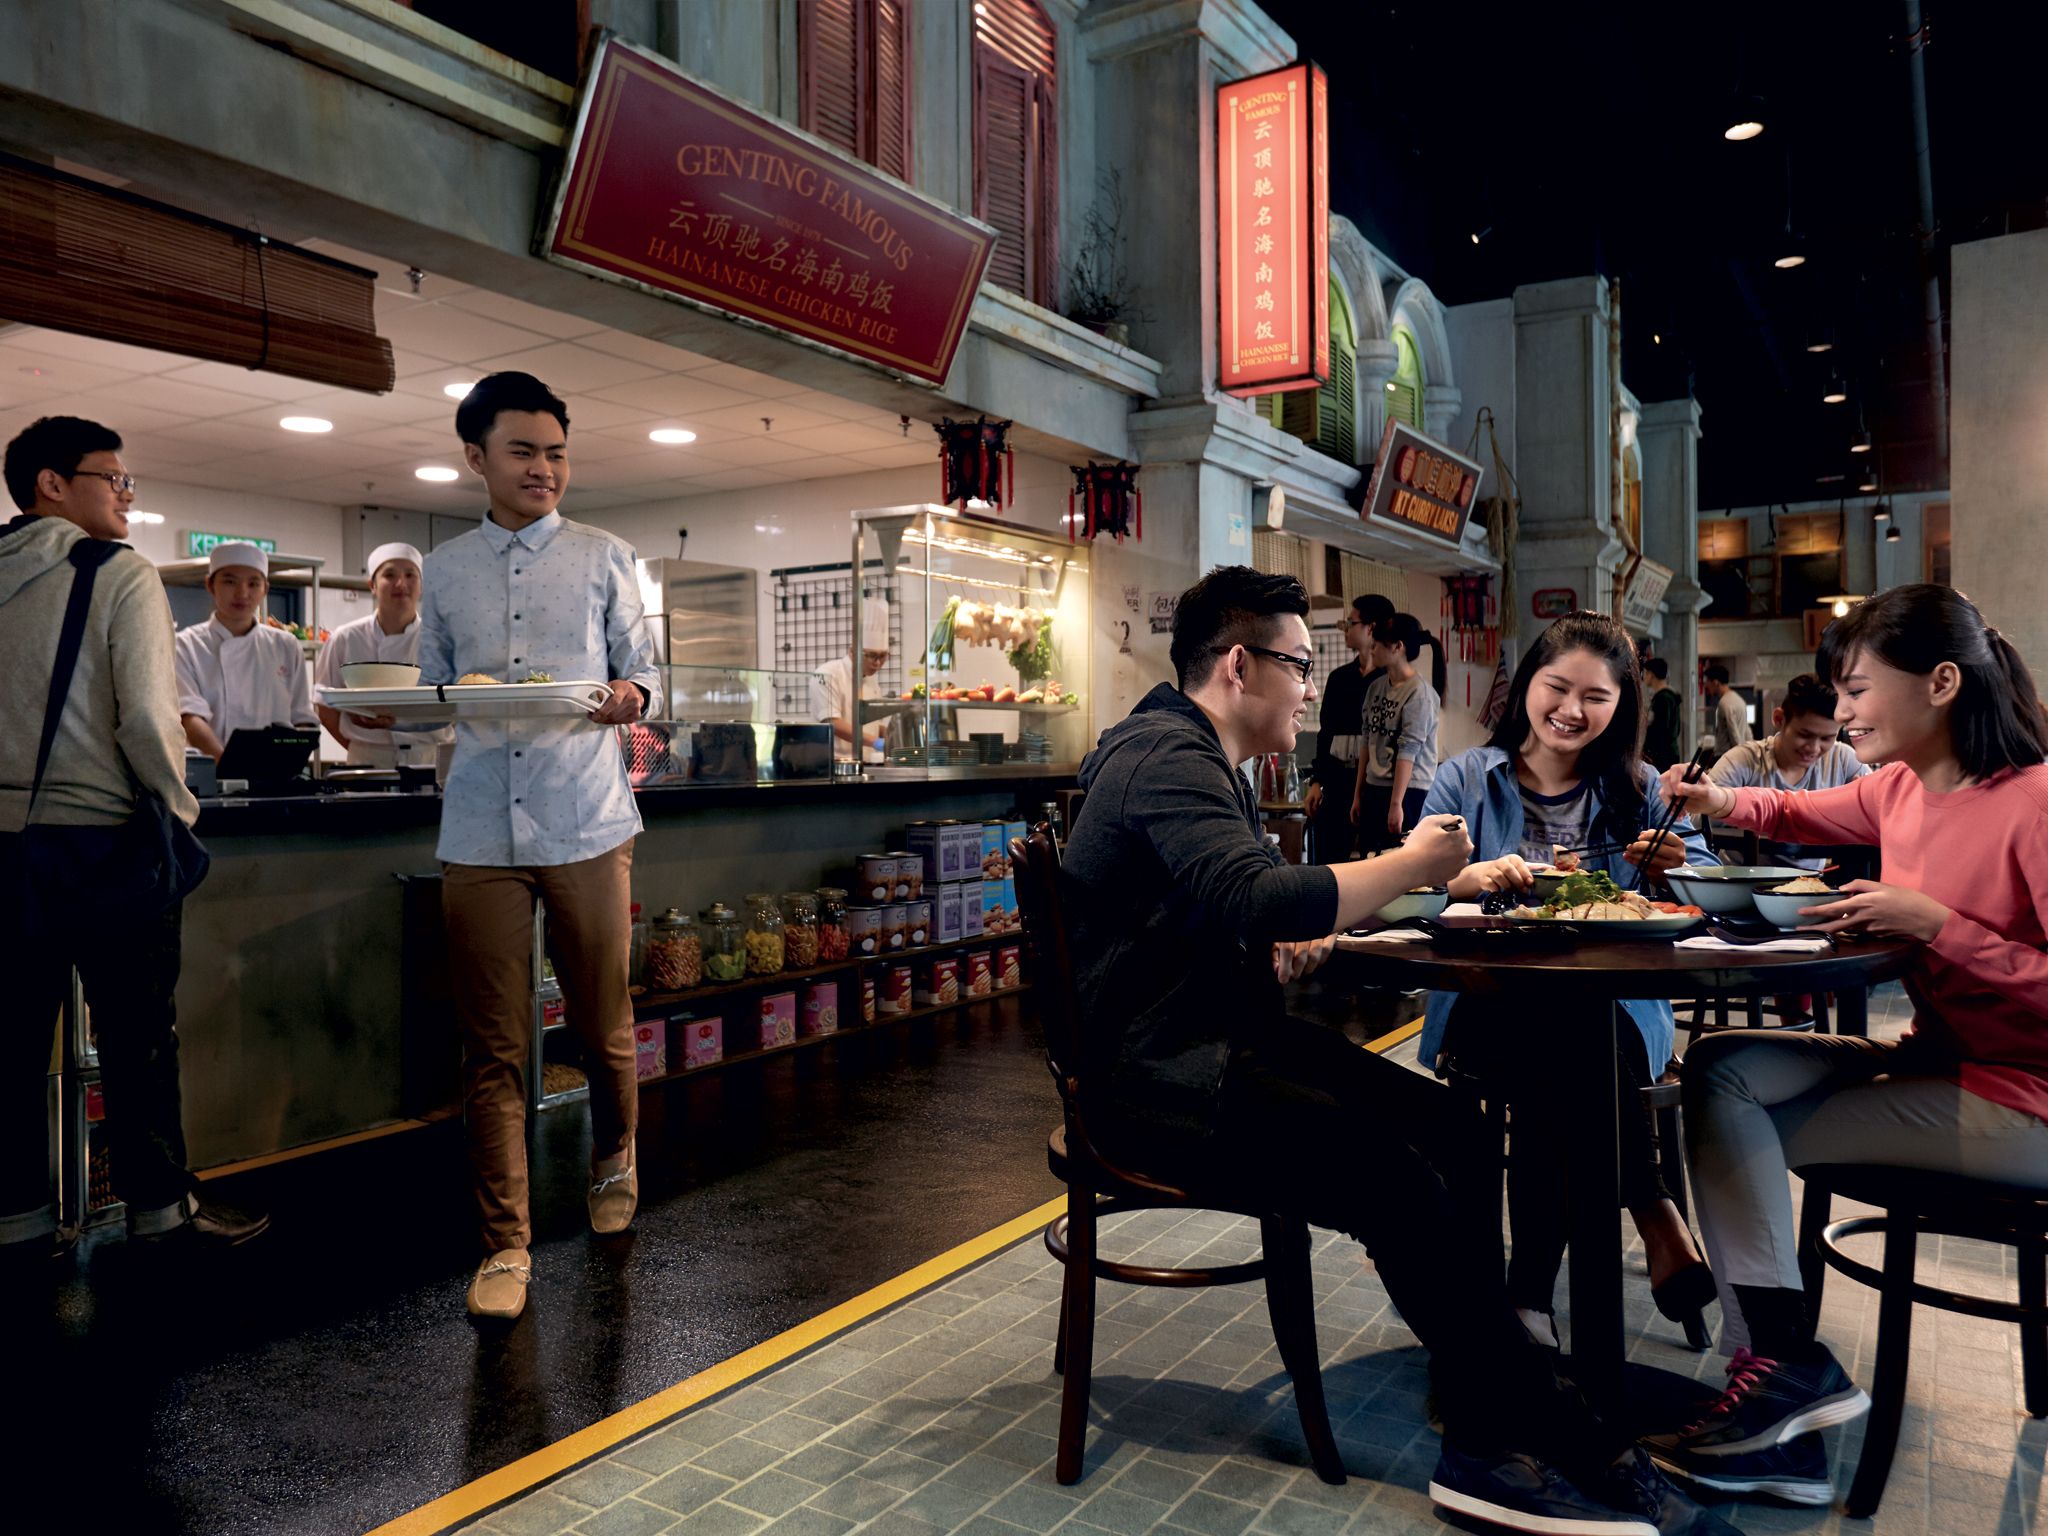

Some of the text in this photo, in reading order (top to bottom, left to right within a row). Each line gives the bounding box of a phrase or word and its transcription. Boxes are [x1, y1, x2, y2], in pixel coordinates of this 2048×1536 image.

[1238, 92, 1287, 113] GENTING
[1245, 104, 1280, 121] FAMOUS
[676, 144, 913, 272] GENTING FAMOUS
[1253, 121, 1275, 340] 云顶驰名海南鸡饭
[668, 201, 897, 316] 云顶驰名海南鸡饭
[648, 237, 899, 346] HAINANESE CHICKEN RICE
[1240, 343, 1289, 360] HAINANESE
[1240, 355, 1272, 367] CHICKEN
[1407, 495, 1436, 527] CURRY
[1433, 506, 1459, 535] LAKSA
